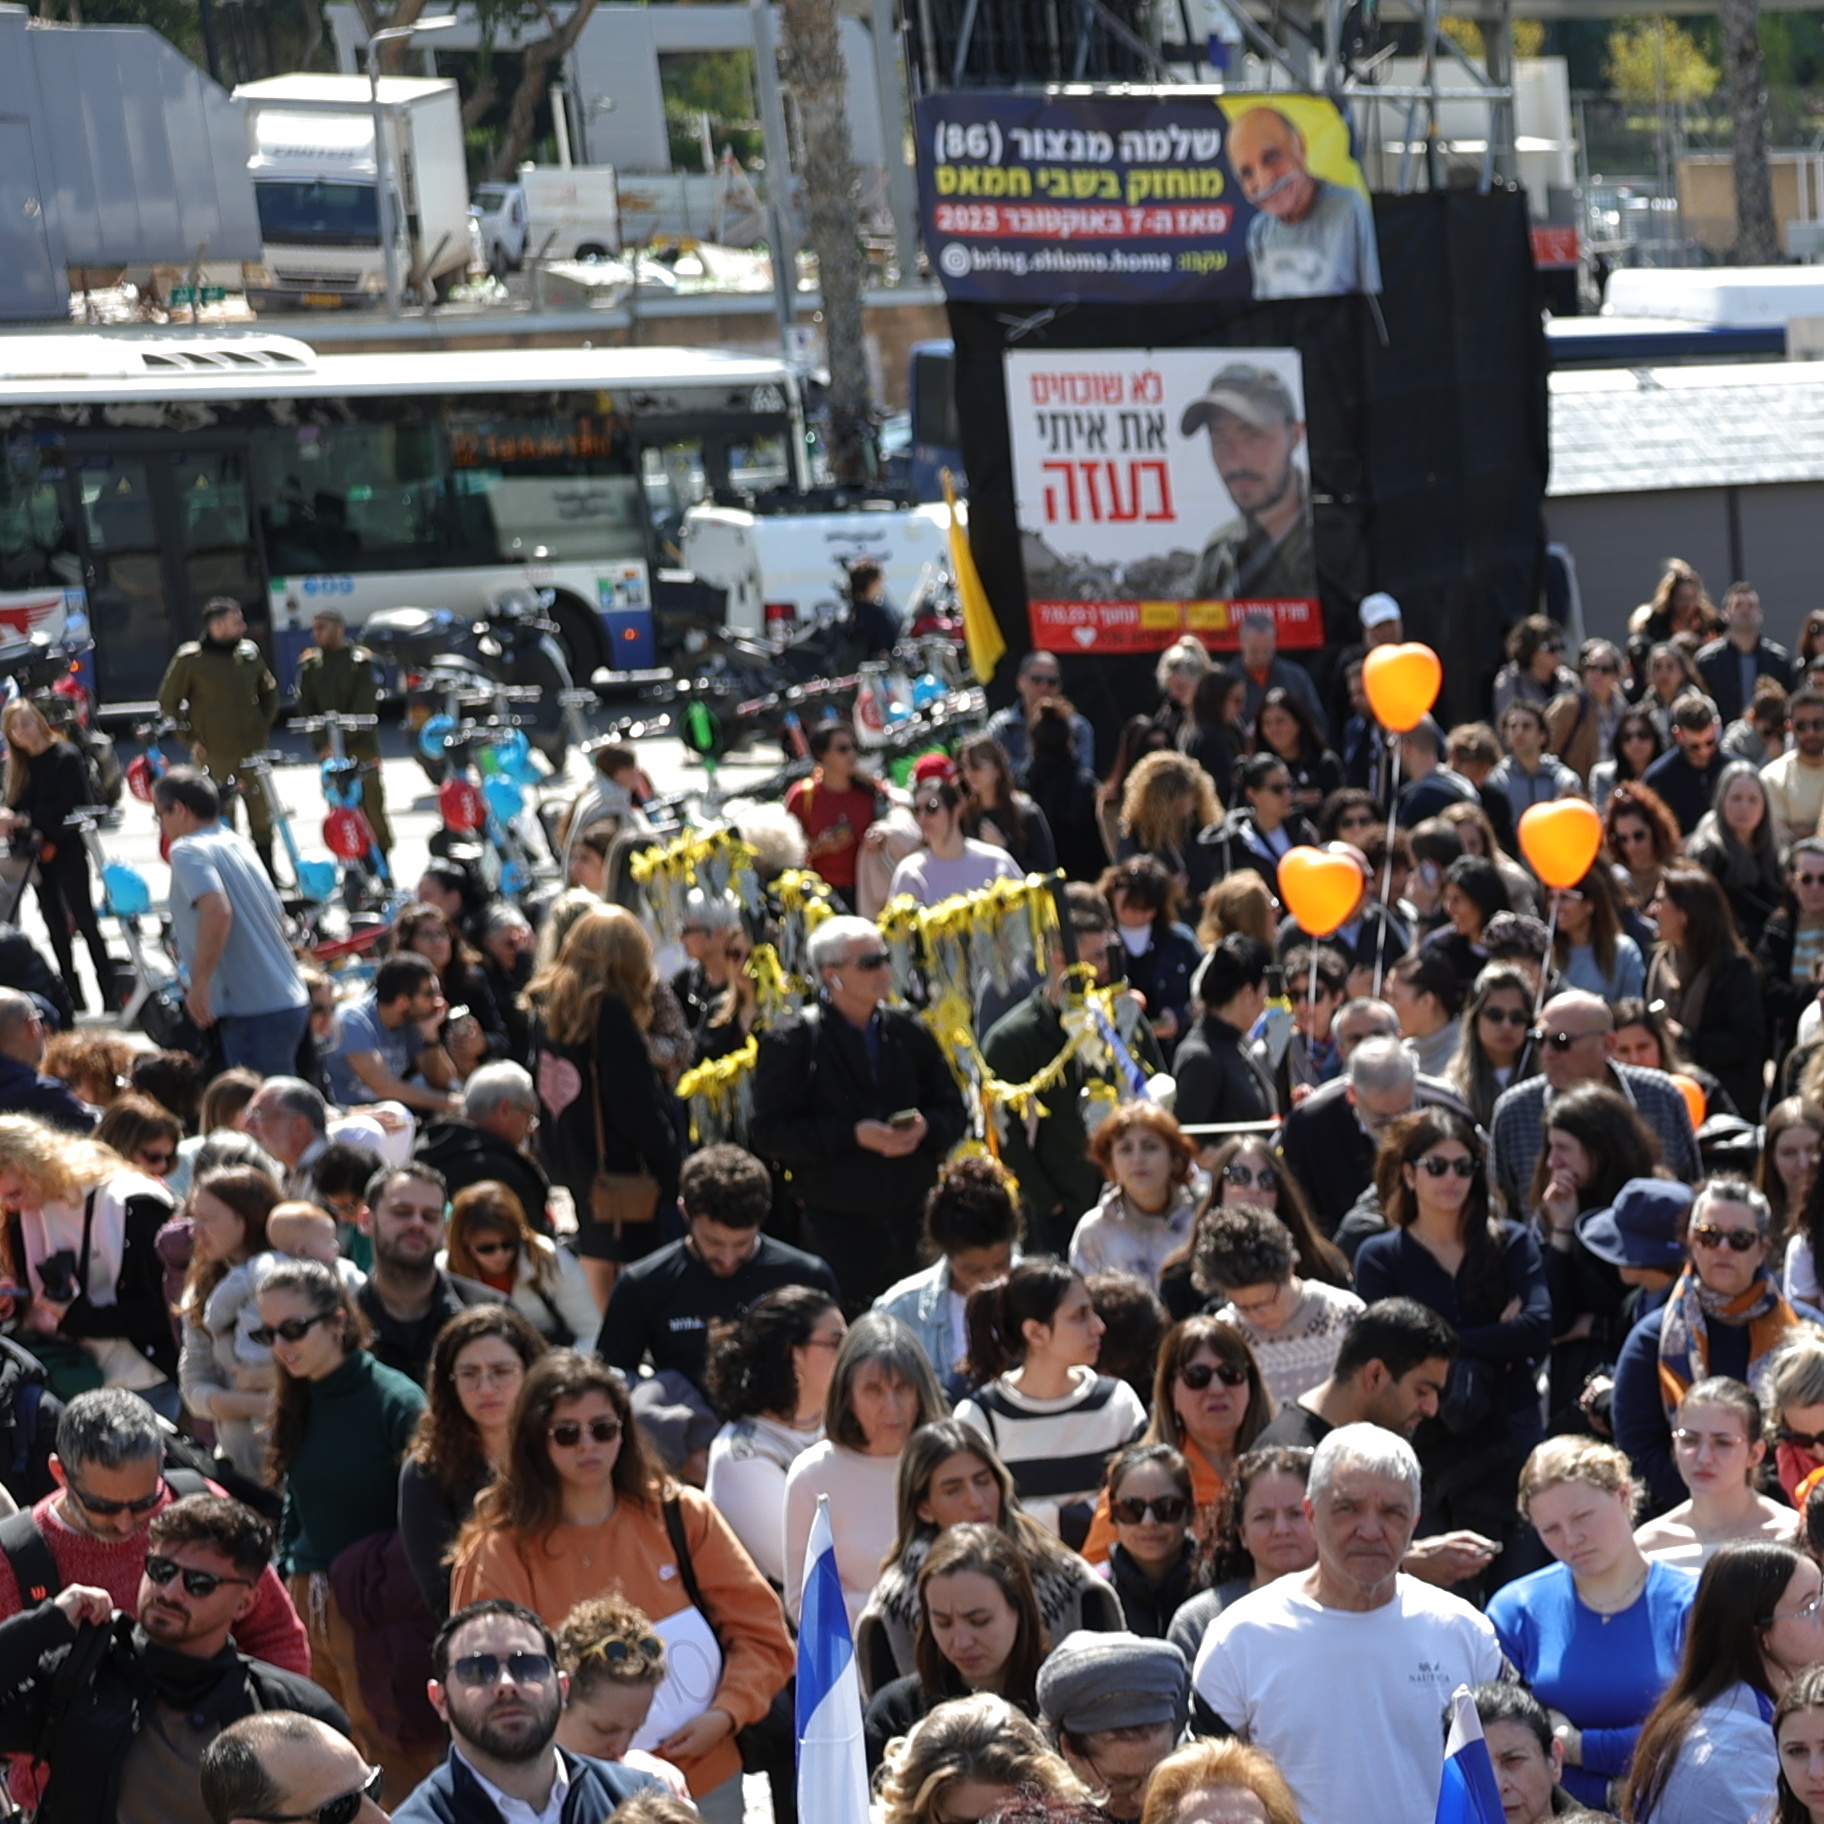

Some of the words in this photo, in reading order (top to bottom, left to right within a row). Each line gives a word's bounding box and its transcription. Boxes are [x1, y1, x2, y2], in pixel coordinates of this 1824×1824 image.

[933, 120, 1002, 166] (86)
[1009, 128, 1114, 162] מנצור
[1118, 122, 1222, 161] שלמה
[934, 166, 1032, 198] חמאס
[1036, 168, 1122, 200] בשבי
[1126, 167, 1225, 205] מוחזק
[935, 204, 999, 233] 2023
[1002, 206, 1125, 239] באוקטובר
[1176, 207, 1228, 233] מאז
[1030, 372, 1124, 405] שוכחים
[1131, 367, 1165, 405] לא
[1036, 410, 1107, 453] איתי
[1119, 410, 1167, 453] את
[1042, 459, 1176, 524] בעזה
